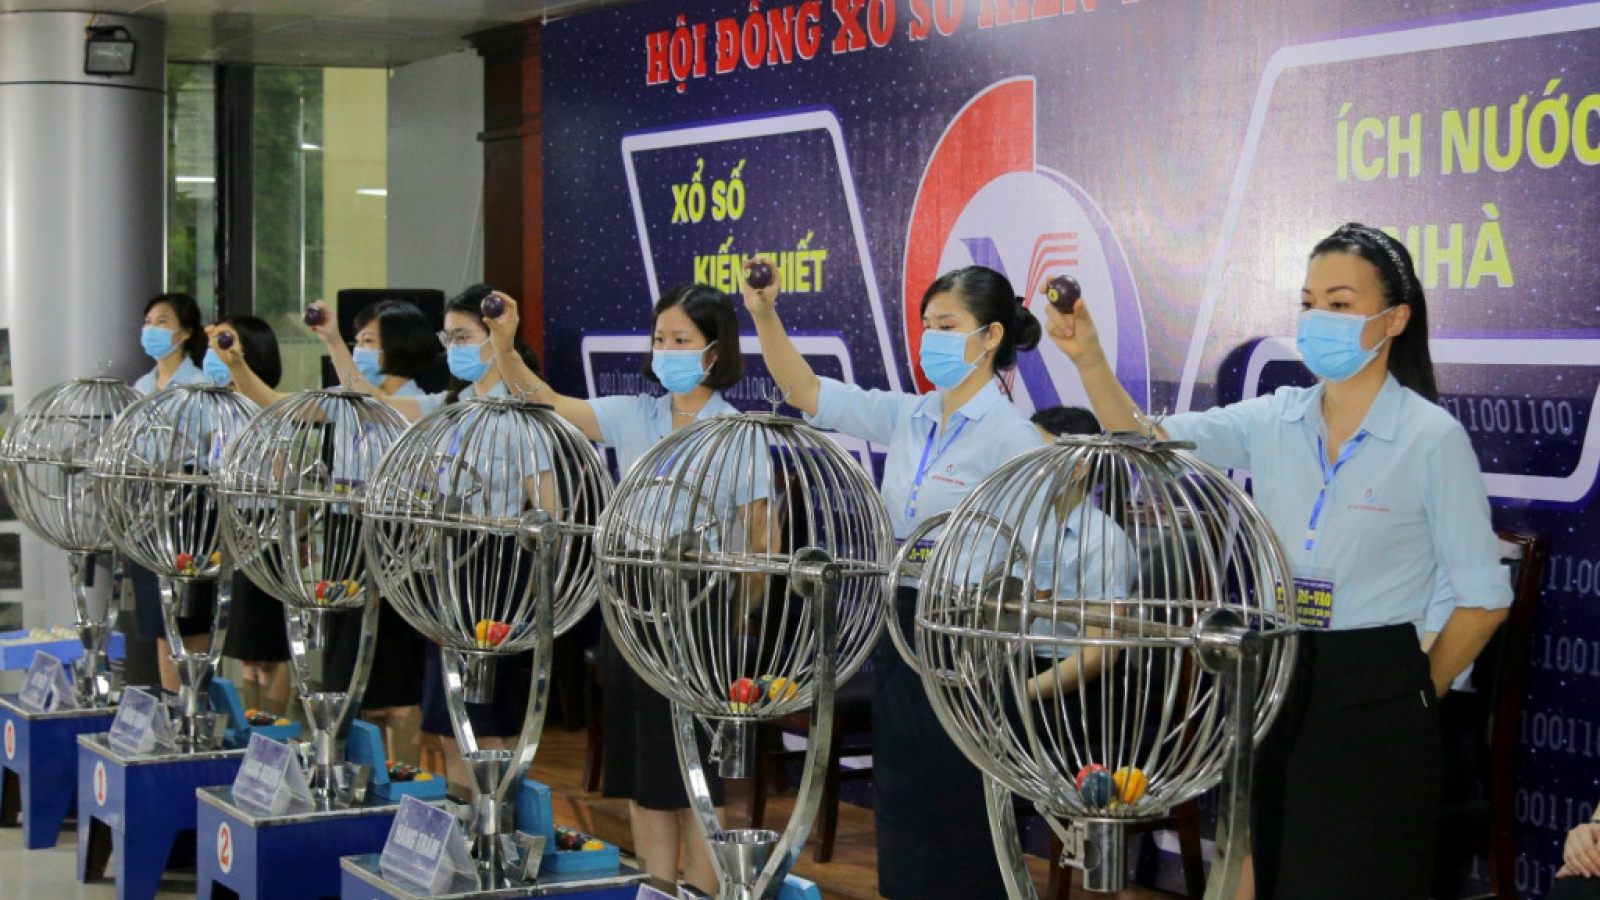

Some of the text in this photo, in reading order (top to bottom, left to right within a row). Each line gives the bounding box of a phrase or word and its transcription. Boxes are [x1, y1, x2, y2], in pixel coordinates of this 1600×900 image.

[645, 14, 707, 94] HỘI
[1336, 78, 1600, 182] ÍCH NƯỚC
[671, 158, 746, 224] XỔ SỐ
[1519, 710, 1600, 757] 10011
[97, 768, 104, 801] 1
[220, 826, 229, 867] 2
